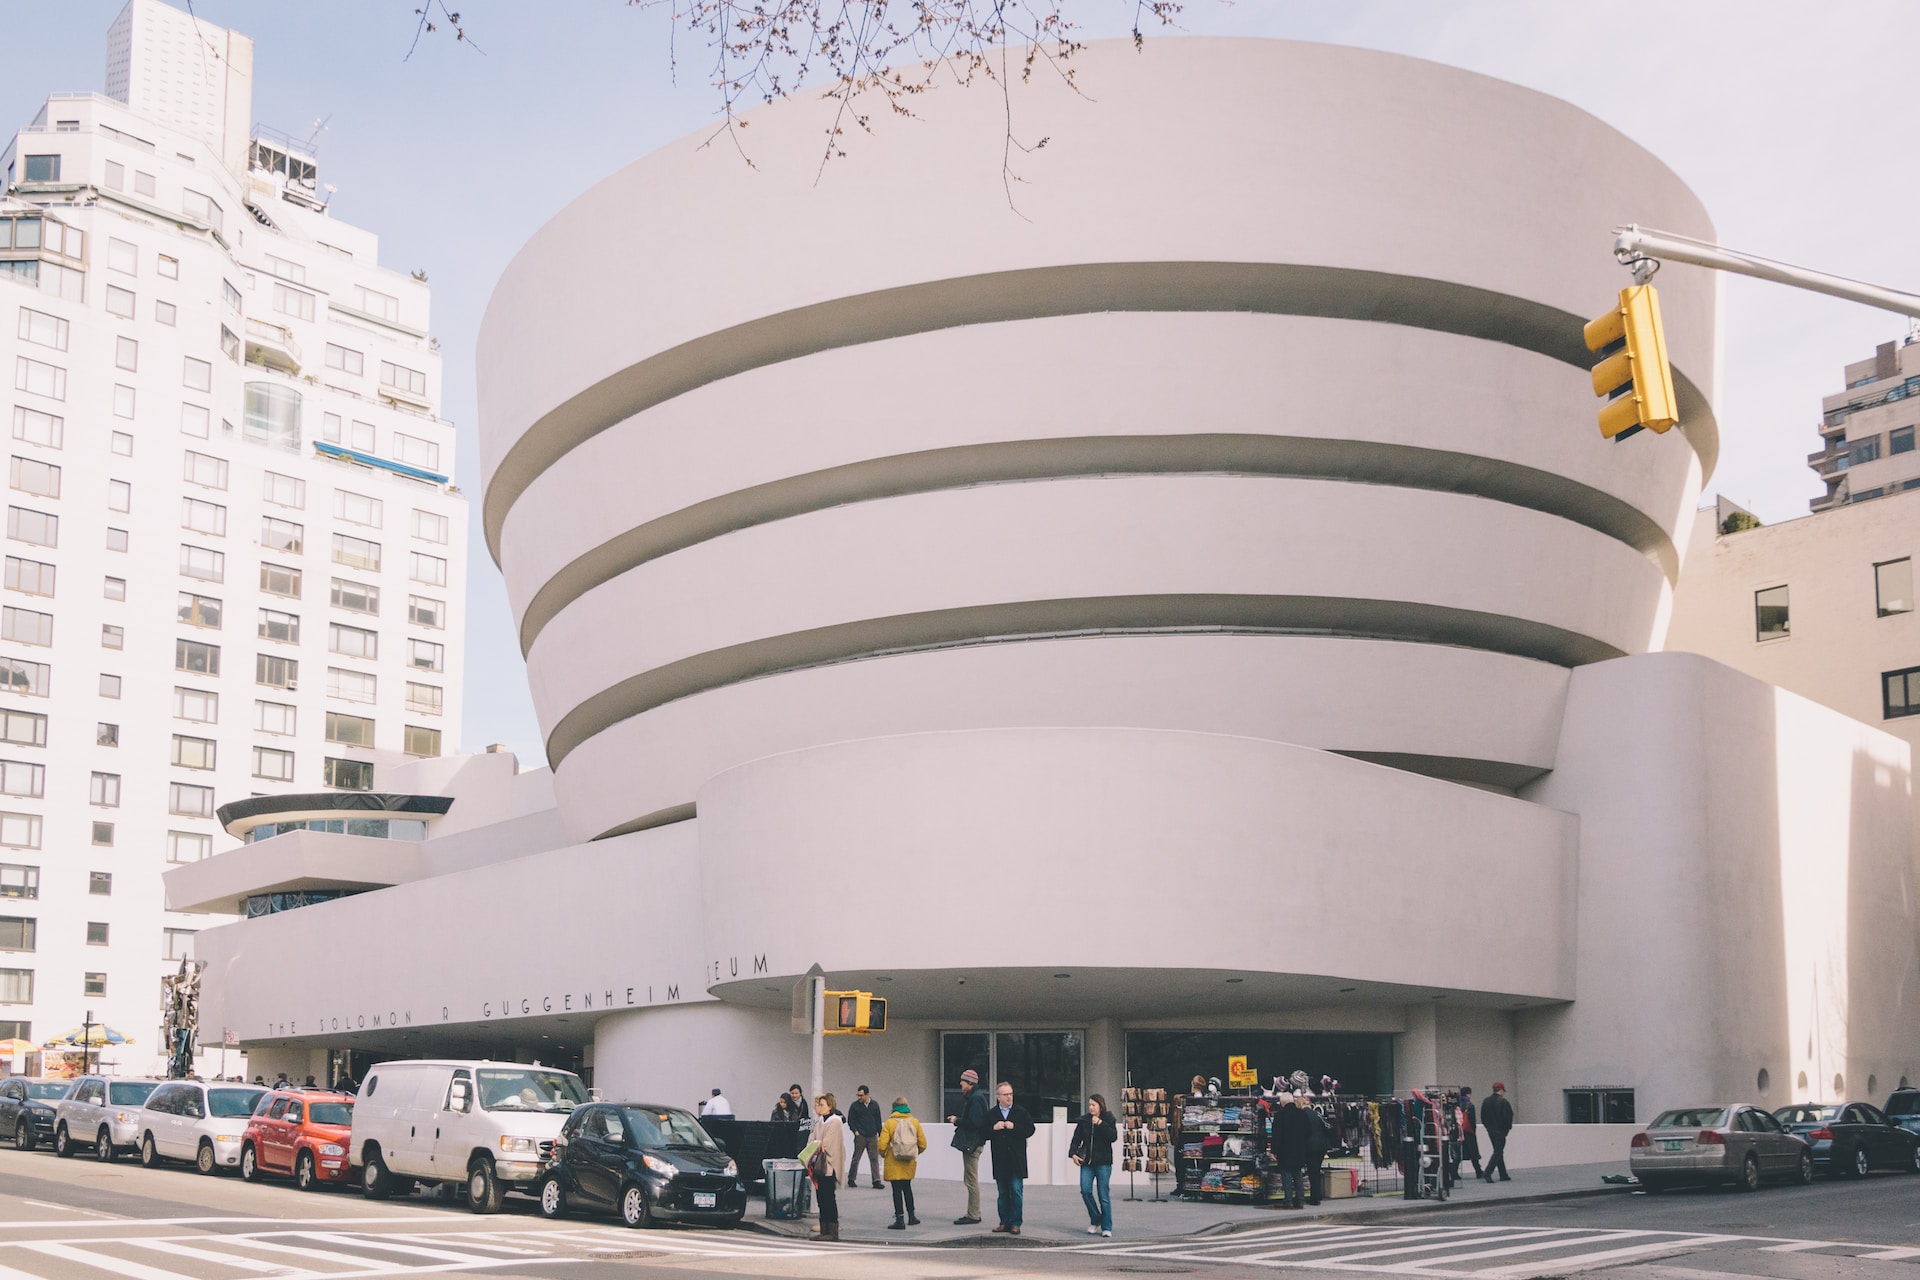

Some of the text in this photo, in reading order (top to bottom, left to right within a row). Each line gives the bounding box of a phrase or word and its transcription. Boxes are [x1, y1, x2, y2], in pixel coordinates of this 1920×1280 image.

[269, 983, 680, 1036] THE SOLOMON R GUGGENHEIM
